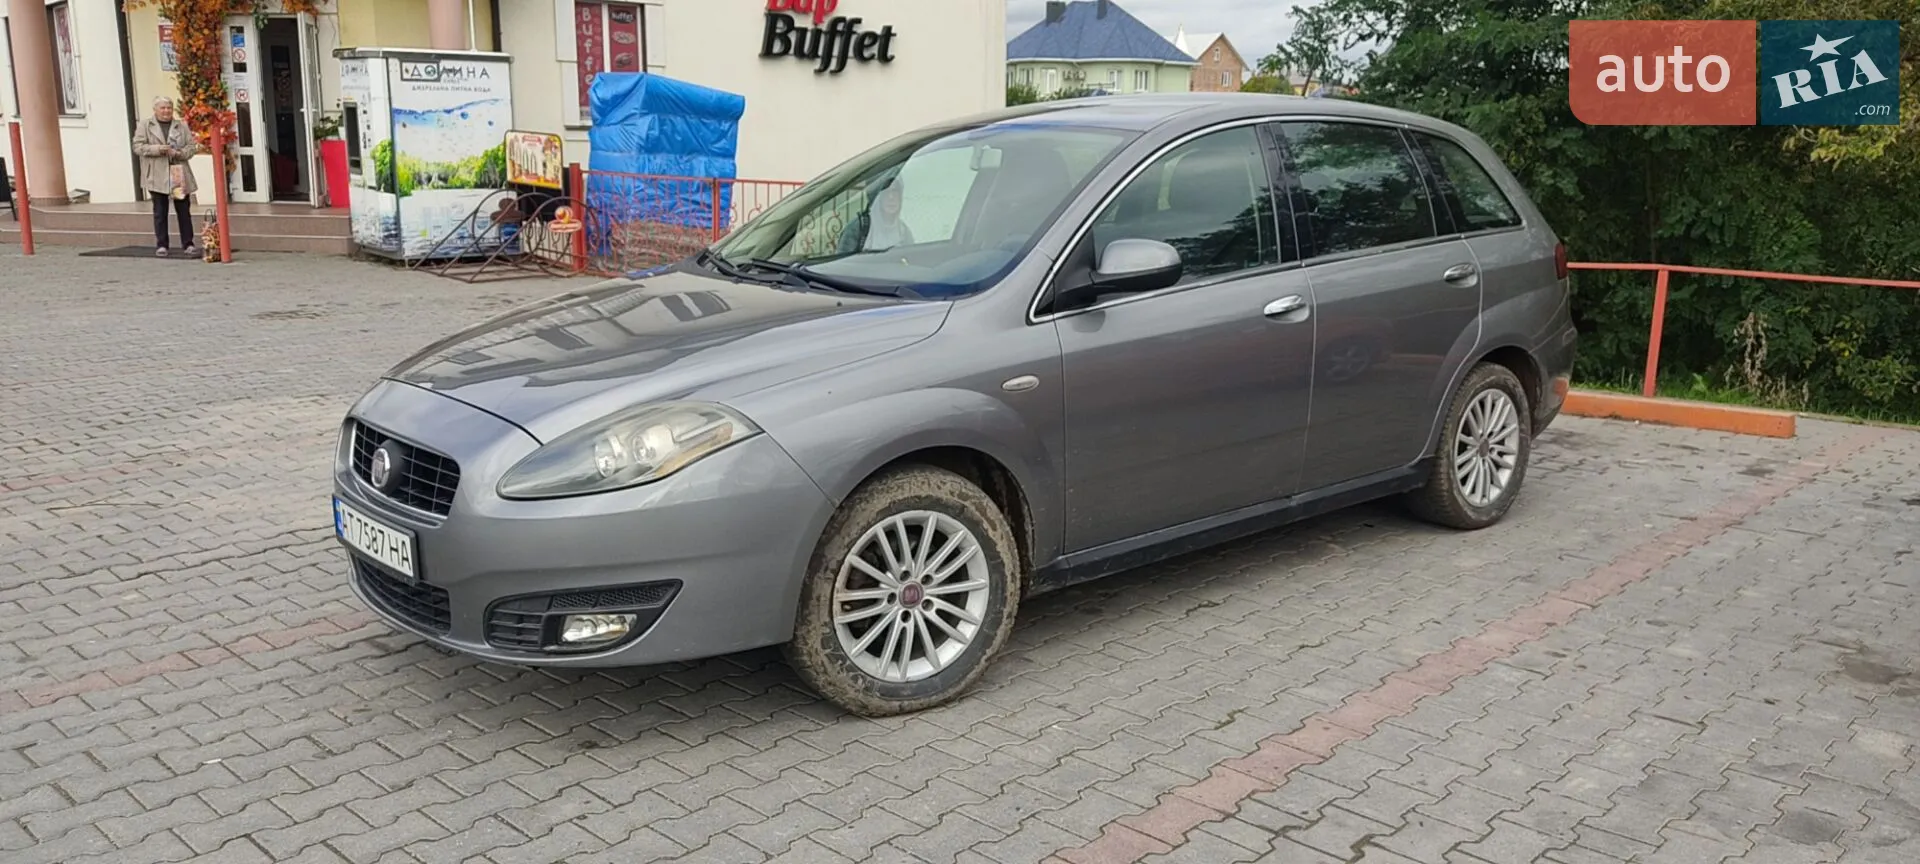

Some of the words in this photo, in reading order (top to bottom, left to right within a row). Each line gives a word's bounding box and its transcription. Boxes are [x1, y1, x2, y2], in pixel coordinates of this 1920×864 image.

[582, 7, 595, 96] Buffe
[759, 12, 897, 74] Buffet
[341, 508, 354, 541] AT
[355, 517, 385, 558] 7587
[387, 533, 412, 572] HA
